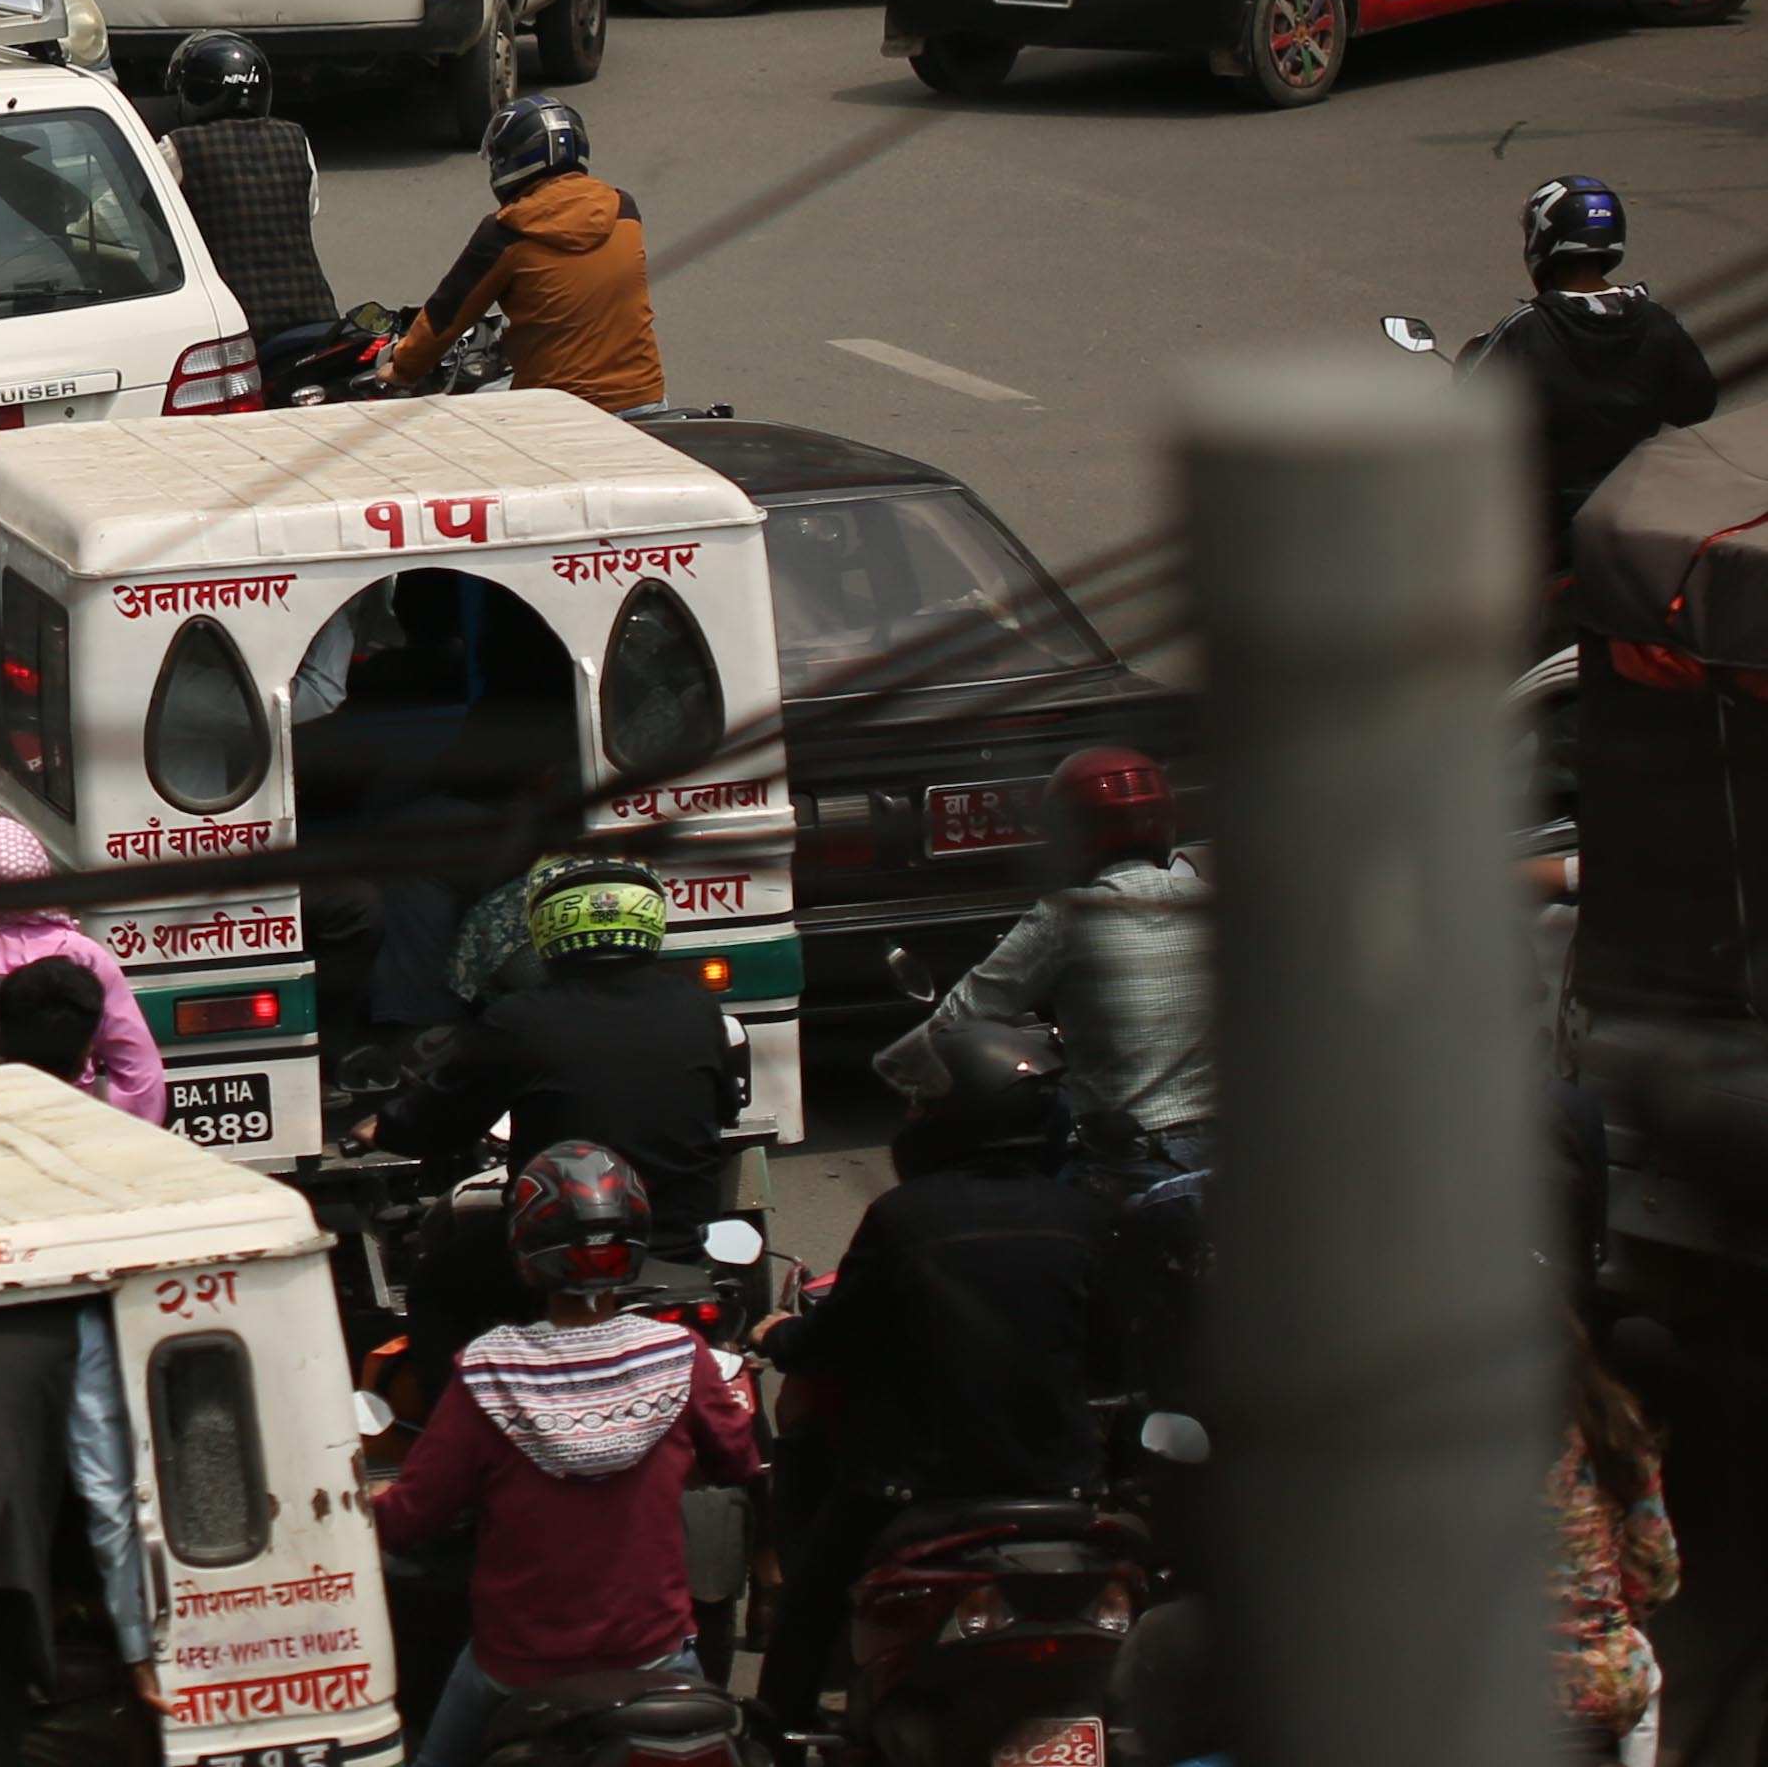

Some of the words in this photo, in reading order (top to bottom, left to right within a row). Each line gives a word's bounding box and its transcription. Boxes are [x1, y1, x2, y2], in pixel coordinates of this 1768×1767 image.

[222, 64, 258, 85] NINJA
[106, 817, 165, 861] नयाँ
[168, 817, 273, 859] बानेश्वर
[239, 906, 298, 954] चोक
[223, 1080, 254, 1103] HA
[167, 1110, 269, 1145] 4389
[302, 1627, 363, 1657] HOUSE
[171, 1663, 376, 1725] नारायणटार
